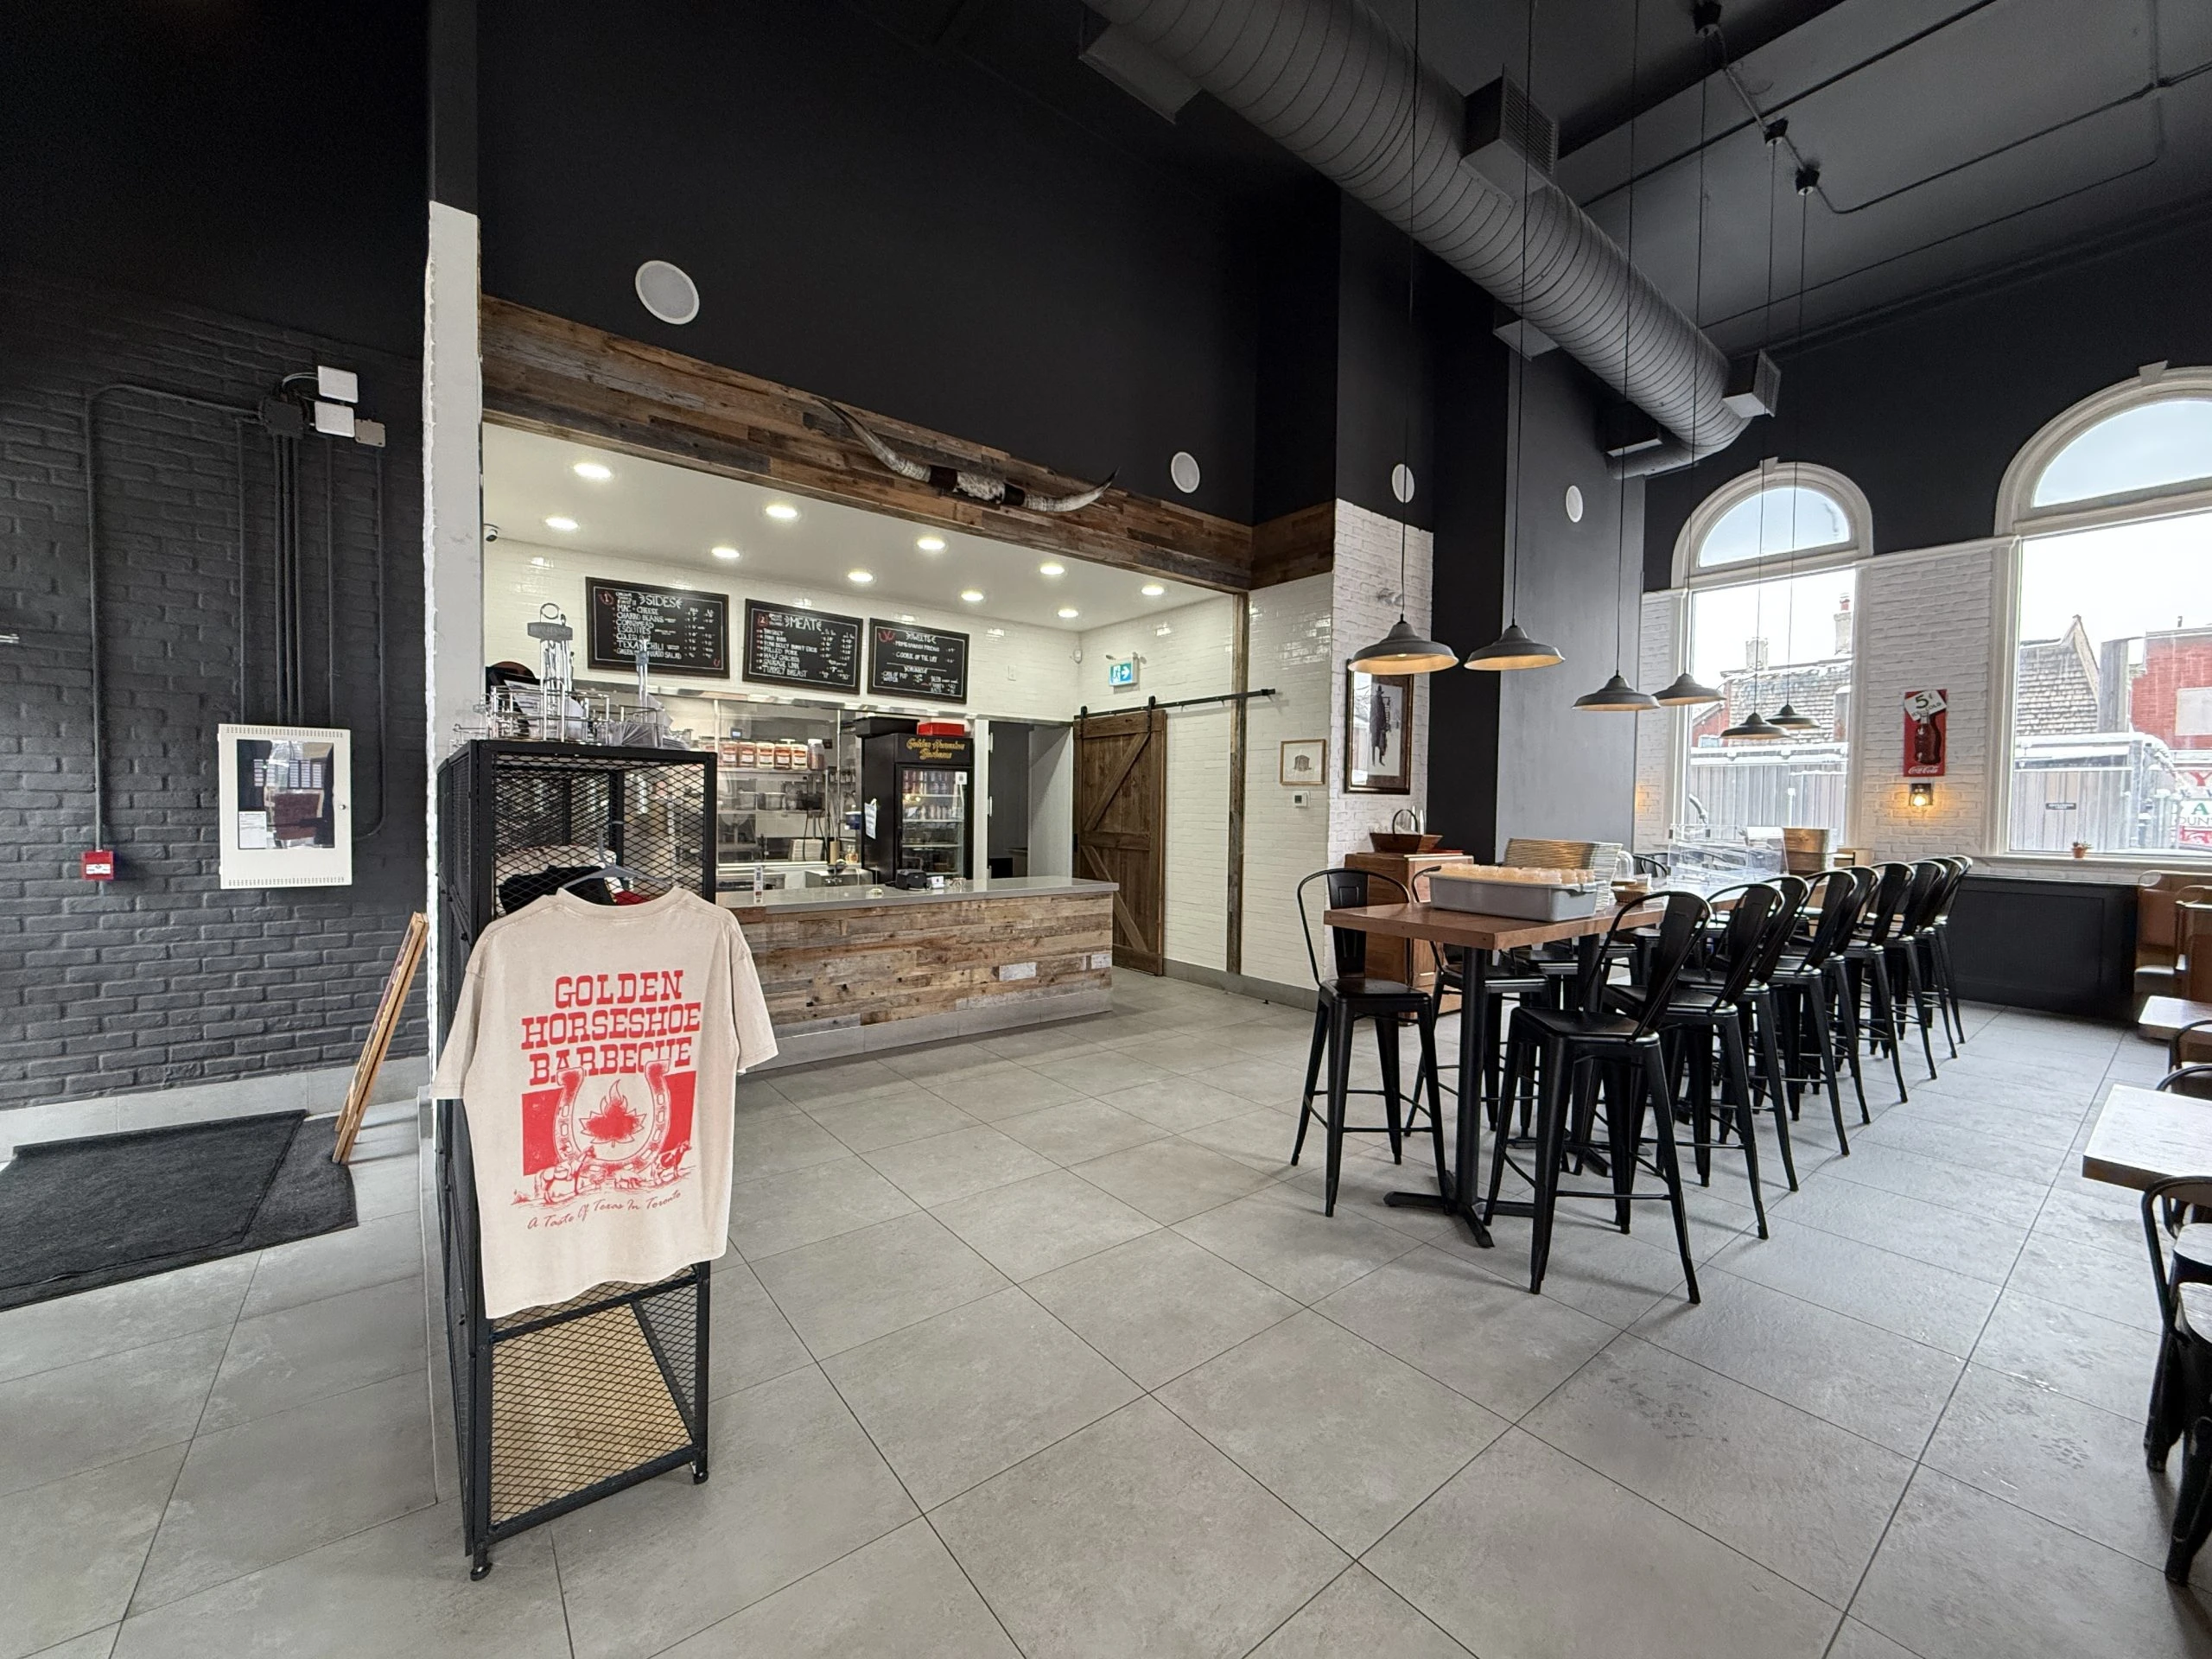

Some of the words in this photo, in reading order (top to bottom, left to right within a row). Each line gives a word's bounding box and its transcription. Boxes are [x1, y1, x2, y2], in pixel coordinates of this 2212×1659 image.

[645, 594, 677, 608] SIDES
[617, 604, 632, 613] MAC
[636, 606, 658, 615] CHEESE
[642, 614, 664, 623] BEANS
[790, 616, 817, 631] MEAT
[617, 626, 652, 635] ESQUITES
[555, 969, 683, 1008] GOLDEN
[521, 1002, 701, 1050] HORSESHOE
[529, 1037, 692, 1086] BARBECUE
[527, 1217, 538, 1230] A
[543, 1213, 575, 1228] Taste
[593, 1198, 624, 1211] Texas
[645, 1189, 682, 1210] Toronto
